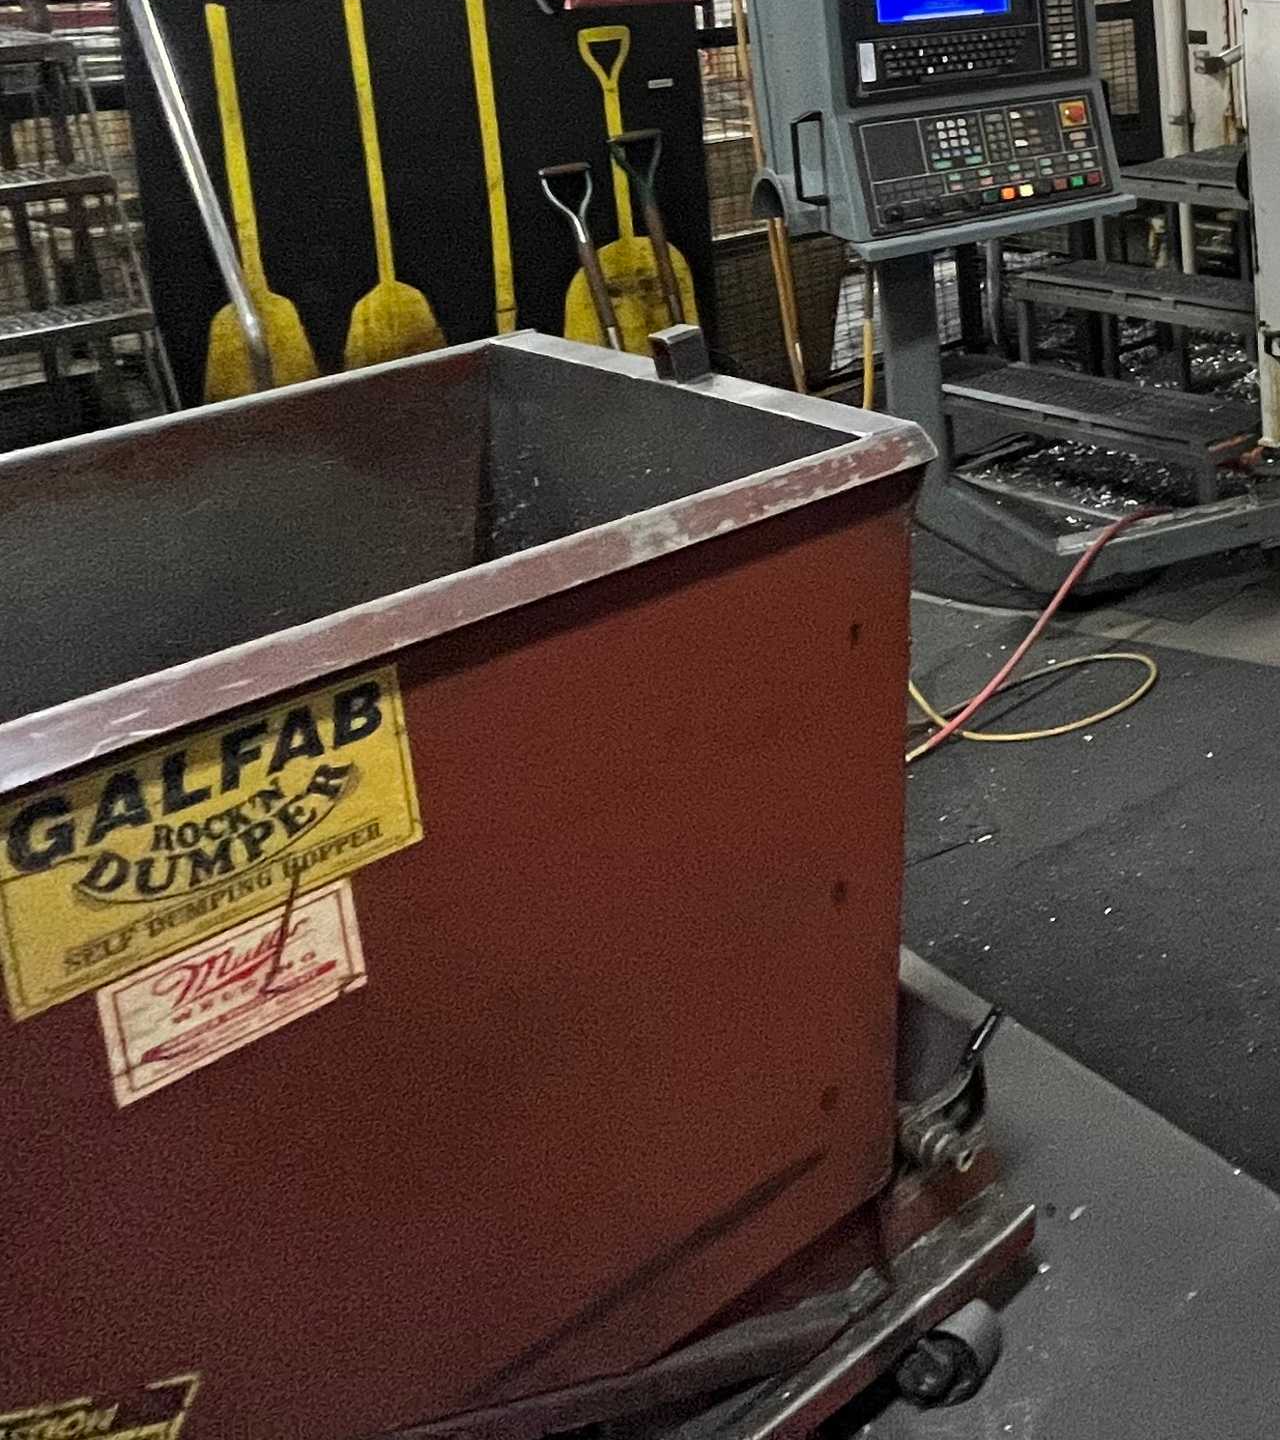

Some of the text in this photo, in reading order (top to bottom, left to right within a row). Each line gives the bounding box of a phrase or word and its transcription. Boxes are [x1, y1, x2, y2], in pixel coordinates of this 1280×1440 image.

[6, 680, 383, 872] GALFAB
[80, 763, 353, 895] DUMPER
[64, 822, 383, 968] SELF DUMPING HOPPER
